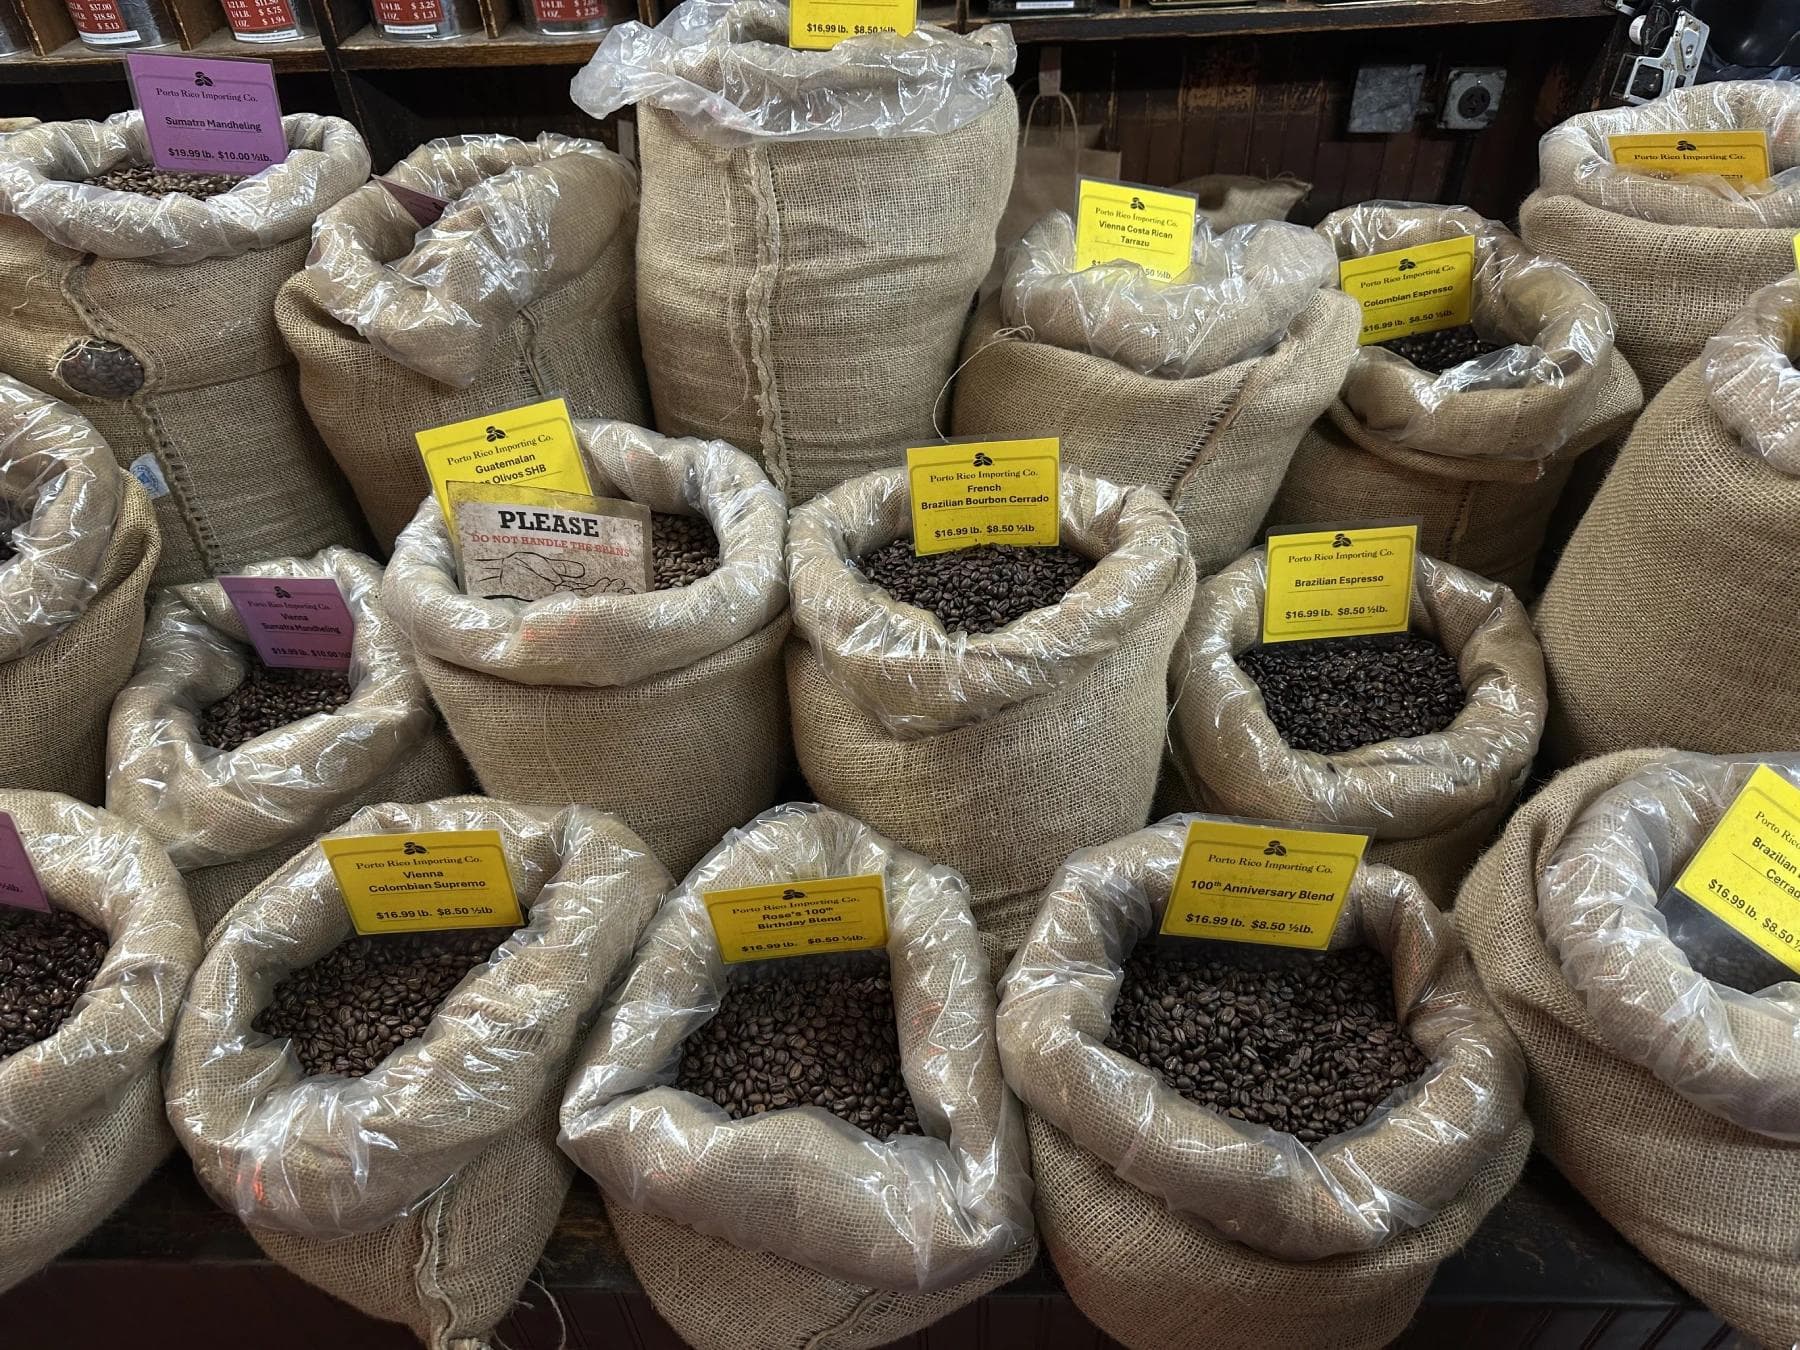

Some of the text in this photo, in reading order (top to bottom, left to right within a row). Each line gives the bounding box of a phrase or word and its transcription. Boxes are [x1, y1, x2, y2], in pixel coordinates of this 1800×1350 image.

[807, 23, 836, 33] $16.99
[838, 25, 848, 33] lb.
[156, 88, 258, 102] Porto Rico Importing Co.
[166, 117, 261, 132] Sumatra Mandheling
[168, 148, 200, 158] $19.99
[202, 149, 214, 158] lb.
[218, 152, 249, 160] $10.00
[1096, 208, 1178, 227] Porto Rico Importing Co.
[1099, 221, 1173, 239] Vienna Costa Rican
[1121, 236, 1149, 246] Tarrazu
[1361, 279, 1381, 288] Porto
[1384, 276, 1400, 285] Rico
[1403, 268, 1440, 280] Importing
[1364, 285, 1453, 307] Colombian Espresso
[1363, 321, 1392, 332] $16.99
[1409, 314, 1434, 324] $8.50
[447, 433, 553, 466] Porto Rico Importing Co.
[475, 453, 536, 474] Guatemalan
[492, 471, 524, 484] Olivos
[526, 464, 546, 476] SHB
[979, 470, 1020, 479] Importing
[967, 484, 1001, 492] French
[921, 495, 1048, 509] Brazilian Bourbon Cerrado
[498, 510, 599, 538] PLEASE
[935, 528, 967, 538] $16.99
[987, 525, 1014, 533] $8.50
[492, 536, 519, 544] NOT
[522, 537, 568, 548] HANDLE
[570, 541, 593, 552] THE
[595, 545, 630, 557] BEANS
[1288, 555, 1311, 563] Porto
[1314, 553, 1333, 561] Rico
[1336, 551, 1377, 560] Importing
[1295, 575, 1384, 587] Brazilian Espresso
[284, 602, 317, 610] Importing
[1286, 610, 1318, 620] $16.99
[1338, 607, 1364, 616] $8.50
[262, 623, 341, 634] Sumatra Mandheling
[1755, 811, 1800, 849] Porto Rico
[1752, 837, 1797, 874] Brazilian
[356, 862, 385, 870] Porto
[413, 857, 463, 866] Importing
[1208, 854, 1332, 874] Porto Rico Importing Co.
[403, 870, 443, 878] Vienna
[369, 880, 485, 893] Colombian Supremo
[1766, 868, 1800, 898] Cerrad
[1223, 884, 1296, 899] Anniversary
[1300, 891, 1335, 901] Blend
[790, 899, 839, 908] Importing
[1708, 878, 1793, 943] $16.99 lb. $8.50
[376, 911, 415, 920] $16.99
[437, 907, 468, 917] $8.50
[763, 911, 802, 920] Rose's
[758, 919, 806, 930] Birthday
[1186, 913, 1228, 925] $16.99
[1231, 917, 1245, 928] lb.
[1251, 920, 1285, 930] $8.50
[741, 943, 781, 952] $16.99
[808, 936, 839, 945] $8.50
